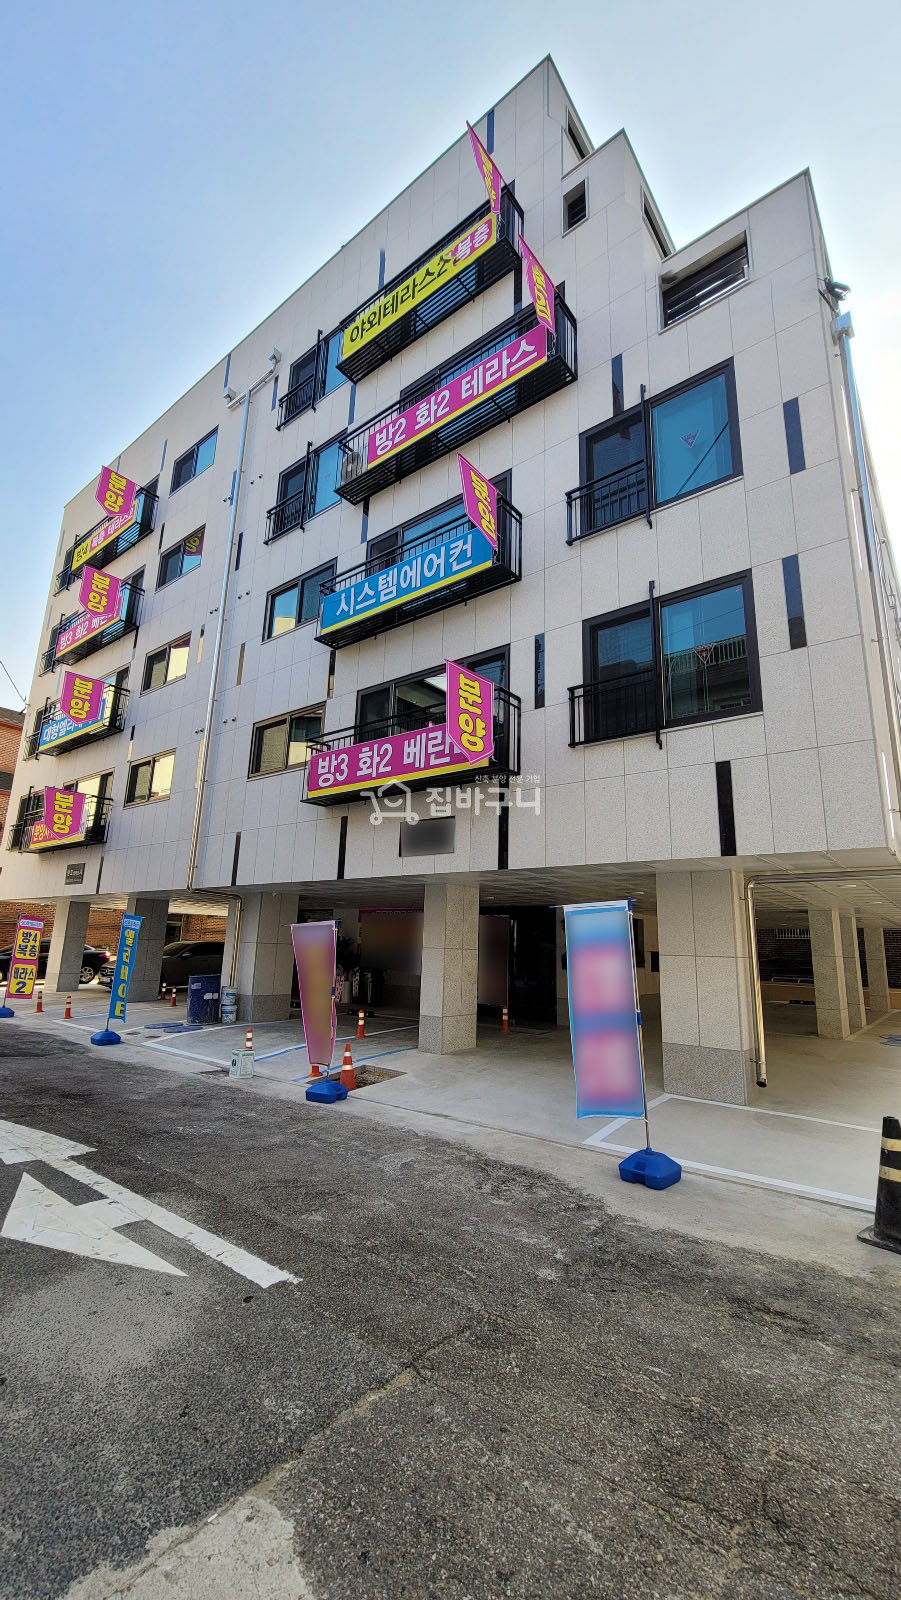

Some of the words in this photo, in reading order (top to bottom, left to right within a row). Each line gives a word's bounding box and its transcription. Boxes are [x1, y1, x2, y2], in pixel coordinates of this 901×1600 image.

[375, 420, 406, 456] 방2
[415, 393, 450, 431] 화2
[462, 340, 538, 400] 테라스
[103, 471, 127, 513] 분양
[470, 469, 497, 541] 분양
[87, 572, 111, 613] 분양
[335, 535, 474, 617] 시스템에어컨
[59, 631, 73, 650] 방3
[74, 621, 89, 640] 화2
[69, 677, 93, 719] 분양
[458, 673, 486, 752] 분양
[317, 750, 348, 786] 방3
[357, 743, 392, 775] 화2
[52, 791, 74, 834] 분양
[16, 943, 38, 958] 복층
[21, 930, 38, 944] 방4
[15, 981, 27, 994] 2
